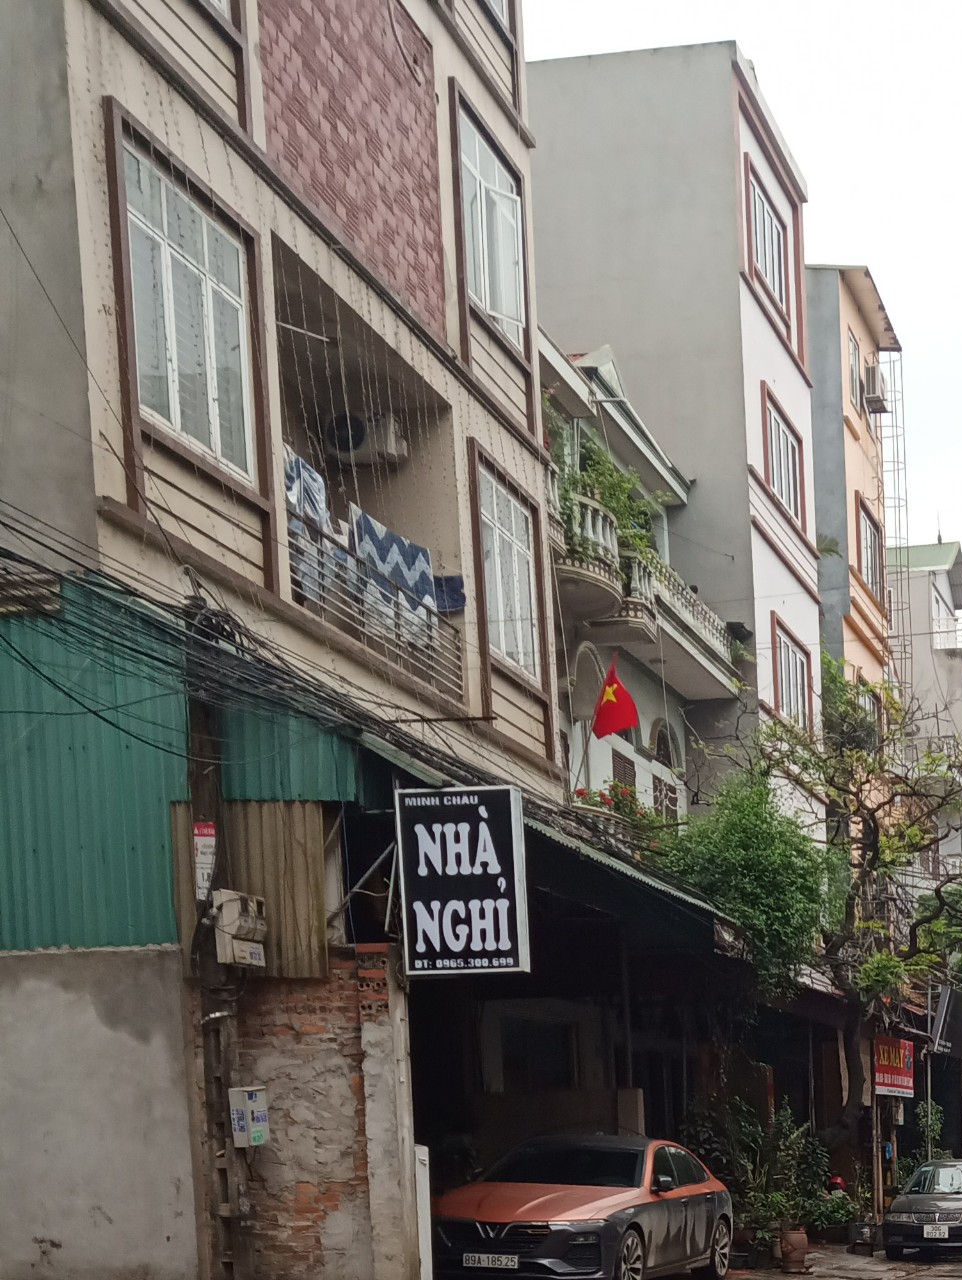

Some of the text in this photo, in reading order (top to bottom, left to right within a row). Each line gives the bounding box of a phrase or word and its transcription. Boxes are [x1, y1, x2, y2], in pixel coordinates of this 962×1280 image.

[405, 794, 478, 806] MINH CHÂU
[414, 806, 501, 876] NHÀ
[413, 877, 512, 953] NGHỈ
[879, 1044, 904, 1068] XE MÁY
